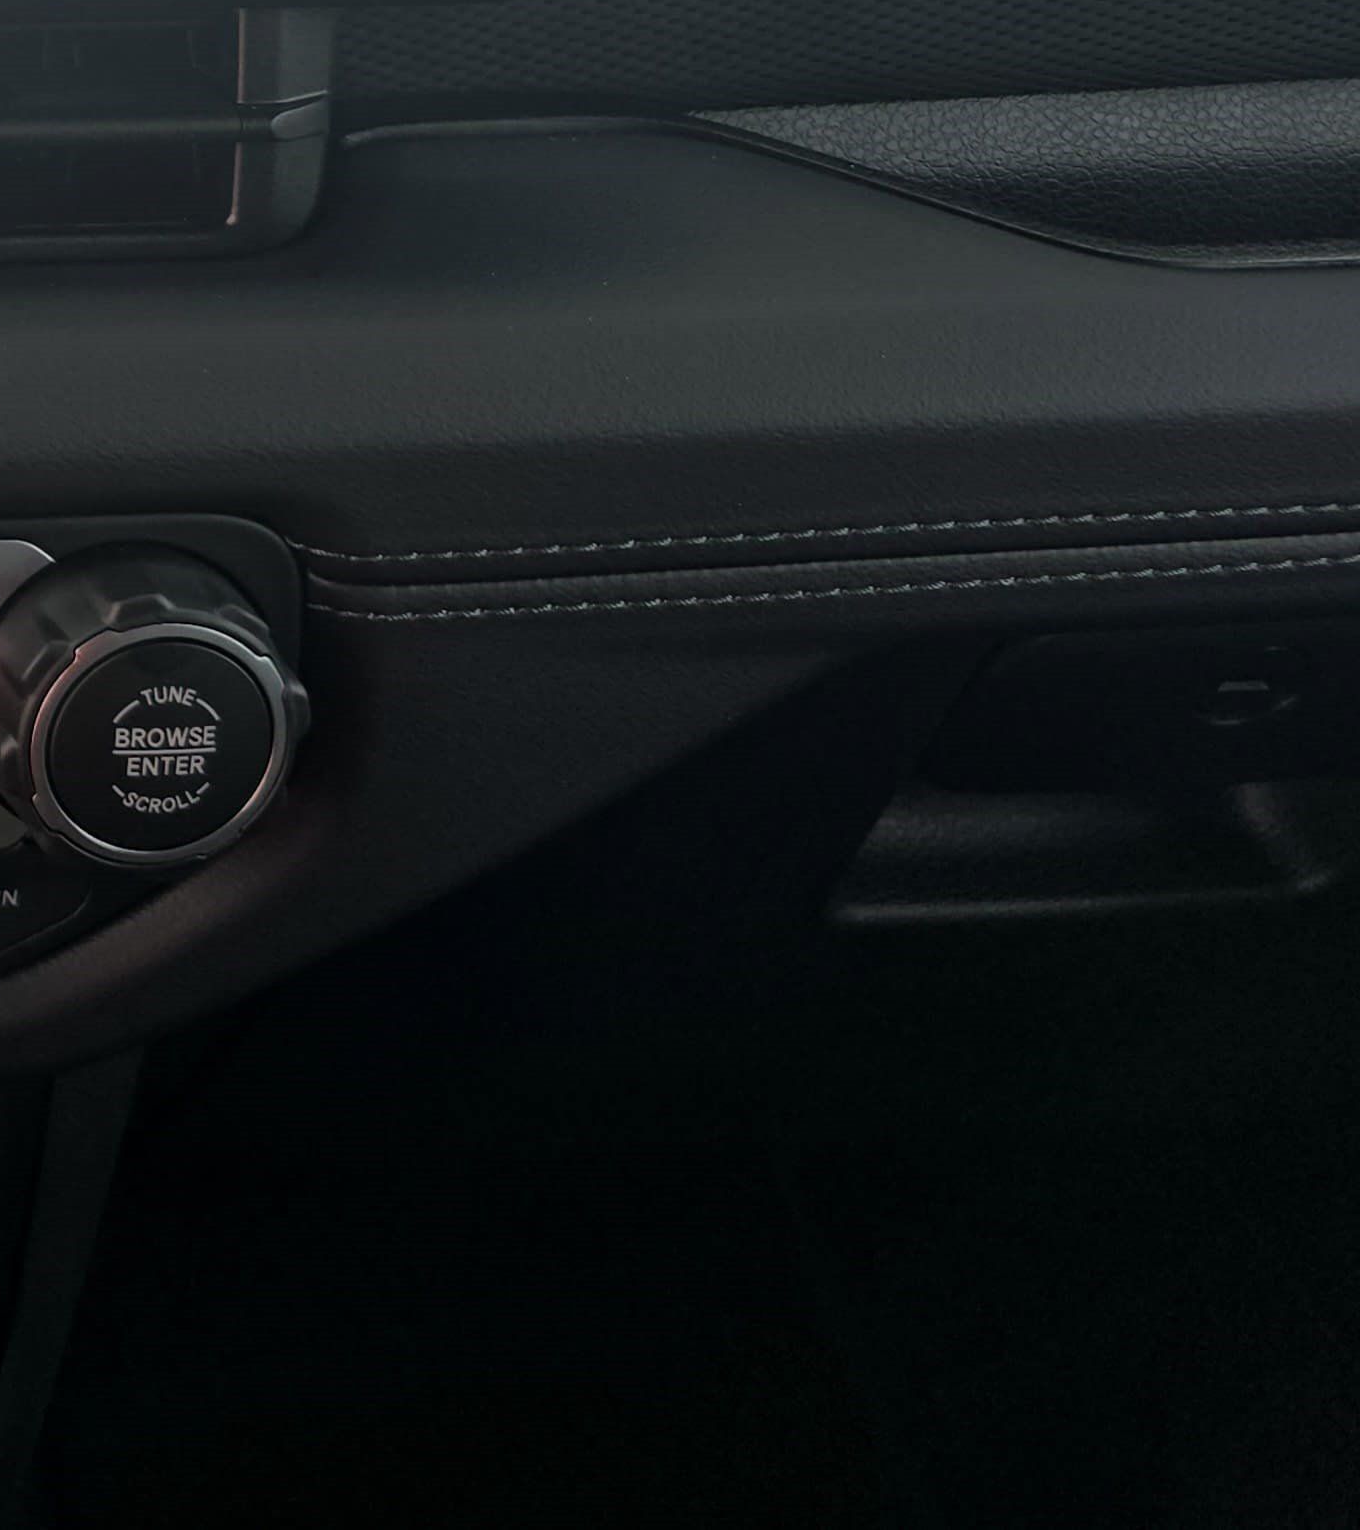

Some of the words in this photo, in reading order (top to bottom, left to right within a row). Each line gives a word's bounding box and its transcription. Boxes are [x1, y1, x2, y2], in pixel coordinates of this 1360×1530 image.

[140, 685, 198, 708] TUNE
[113, 725, 217, 750] BROWSE
[125, 755, 206, 778] ENTER
[122, 789, 200, 815] SCROLL
